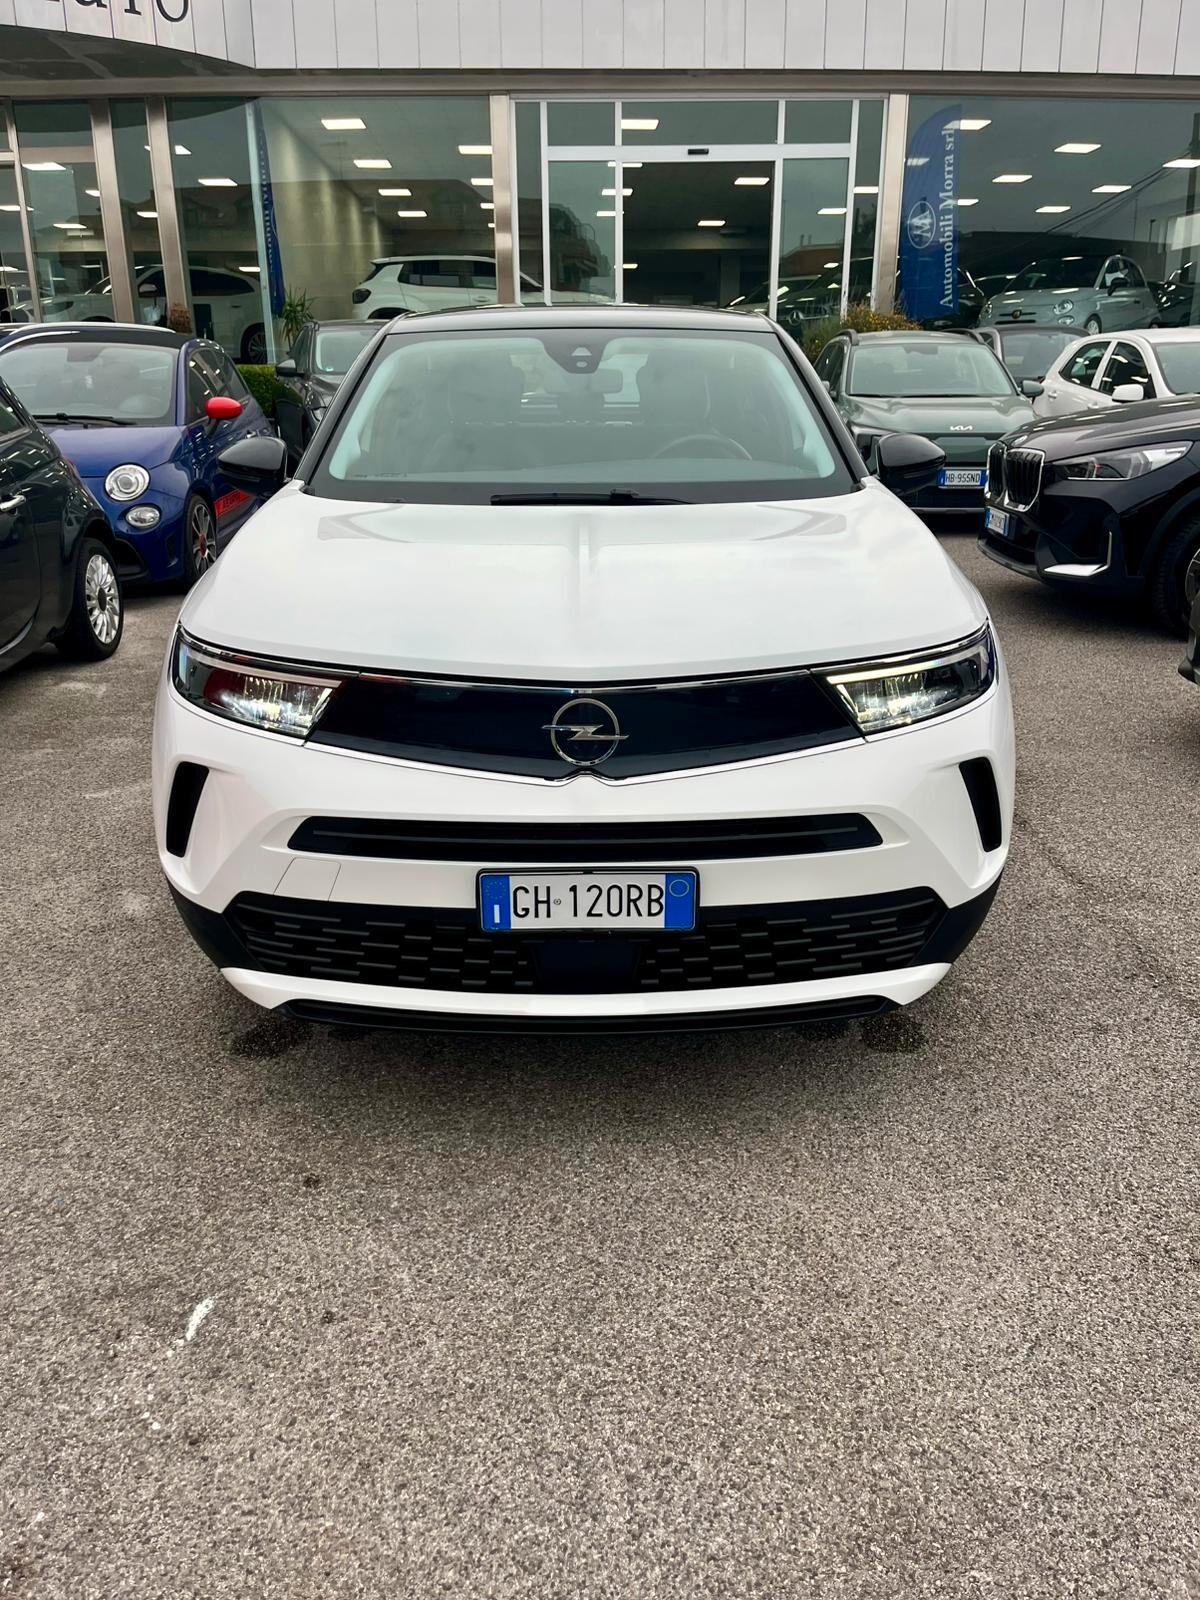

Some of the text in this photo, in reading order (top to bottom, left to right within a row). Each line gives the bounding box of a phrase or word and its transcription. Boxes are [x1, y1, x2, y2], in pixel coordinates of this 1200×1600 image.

[939, 154, 955, 210] Morra
[939, 215, 954, 308] Automobili
[512, 885, 552, 919] GH
[568, 884, 665, 918] 120RB
